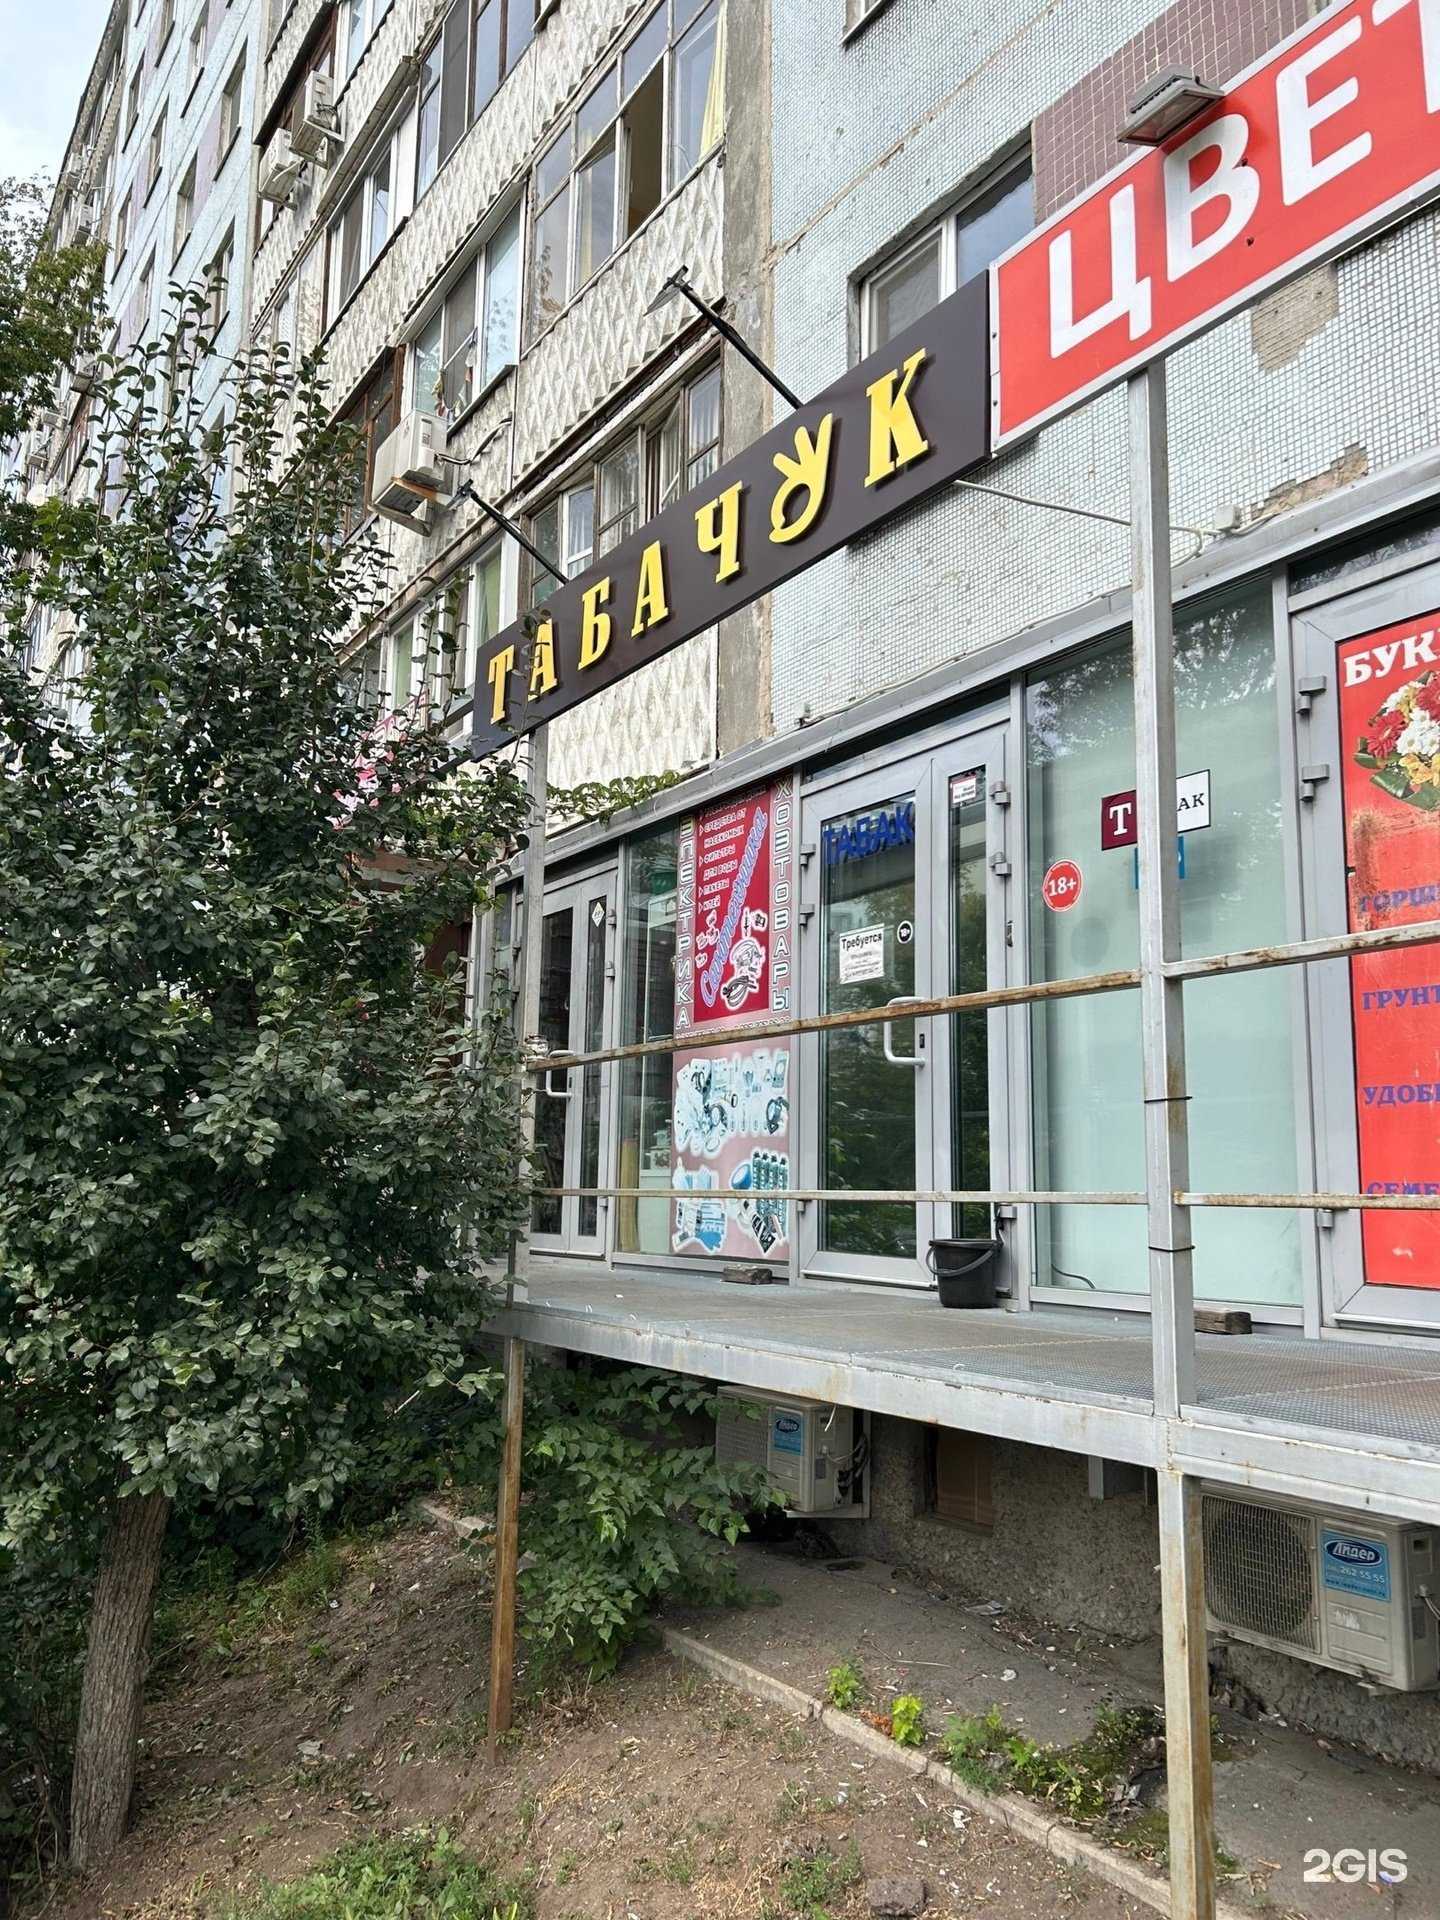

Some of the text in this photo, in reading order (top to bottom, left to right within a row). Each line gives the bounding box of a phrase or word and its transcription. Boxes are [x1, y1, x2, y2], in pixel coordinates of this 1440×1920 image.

[488, 347, 930, 725] ТАБАЧОК
[1343, 629, 1440, 687] БУК
[771, 780, 793, 1012] ХОЗТОВАРЫ
[1048, 879, 1077, 897] 18+
[1360, 884, 1440, 913] ГОРШ
[675, 816, 696, 1029] ЭЛЕКТРИКА
[842, 933, 882, 951] Требуется
[1362, 1083, 1440, 1107] УДОБ
[1333, 1542, 1376, 1561] Лидер
